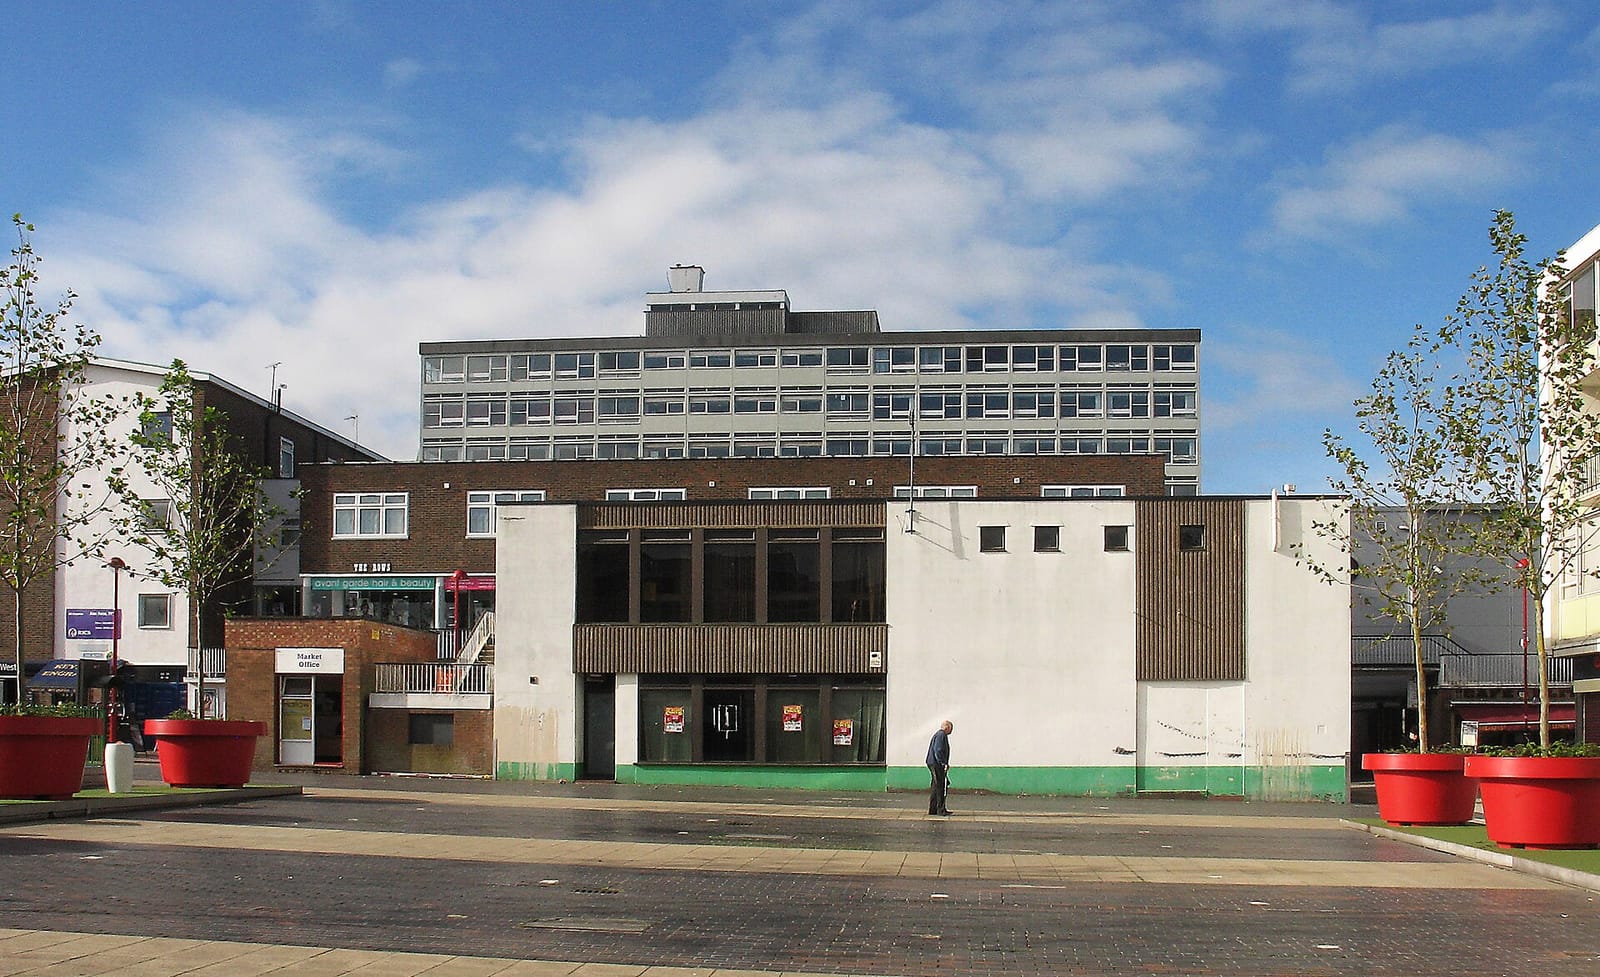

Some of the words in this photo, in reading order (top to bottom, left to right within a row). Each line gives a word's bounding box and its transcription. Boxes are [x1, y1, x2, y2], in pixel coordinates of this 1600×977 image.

[353, 563, 368, 572] THE
[314, 579, 340, 587] avant
[342, 578, 369, 589] garde
[372, 578, 389, 587] hair
[400, 578, 432, 589] beauty
